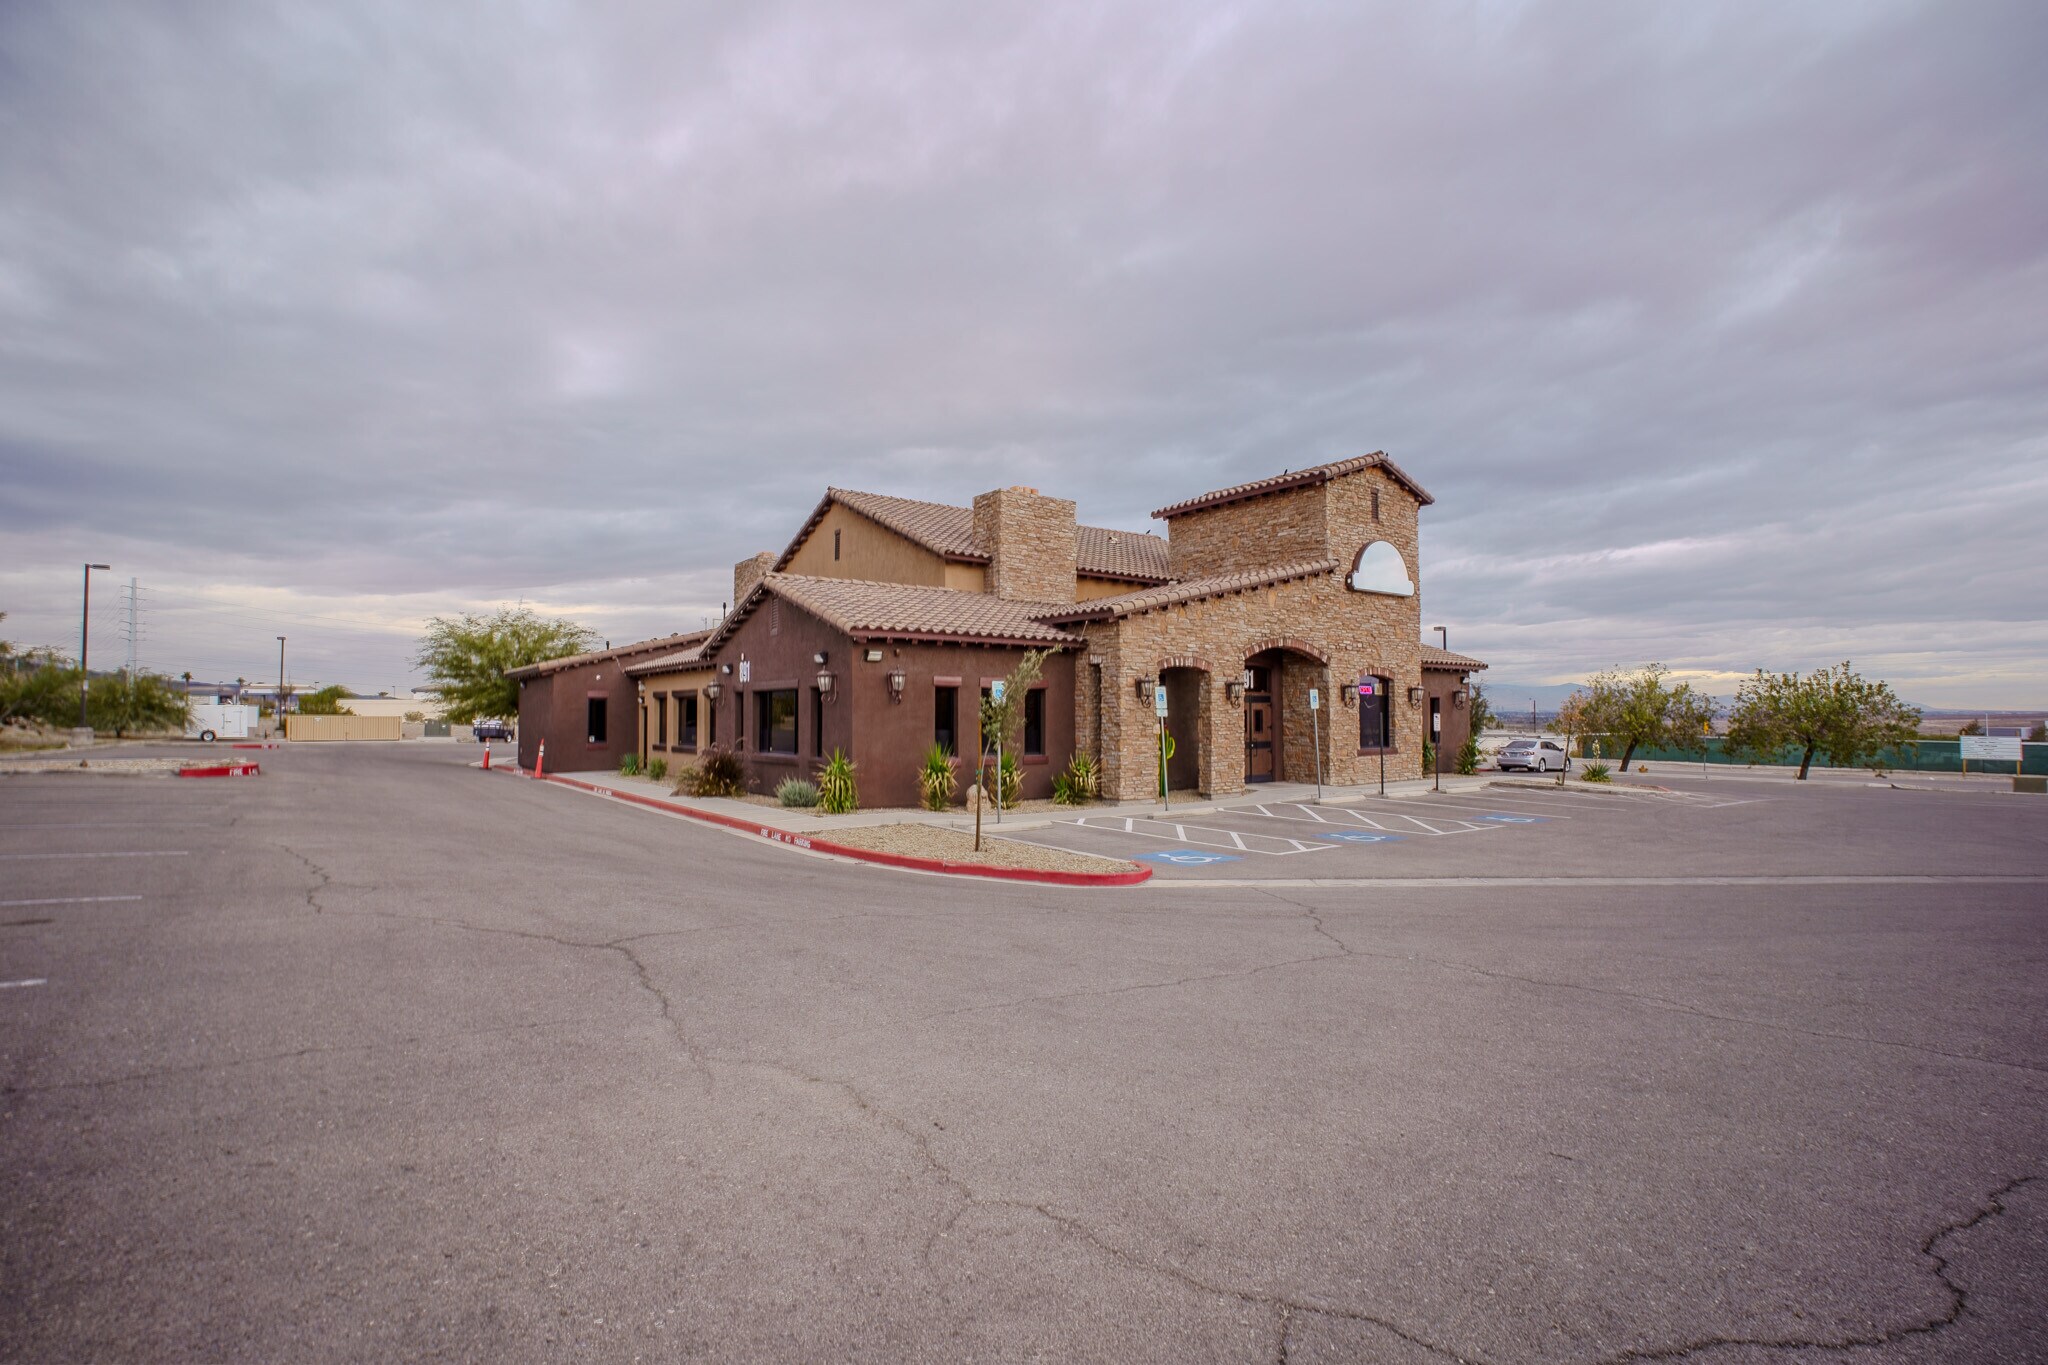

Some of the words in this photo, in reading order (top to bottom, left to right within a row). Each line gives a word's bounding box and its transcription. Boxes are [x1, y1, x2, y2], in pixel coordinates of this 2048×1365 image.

[740, 660, 750, 682] 891
[771, 830, 781, 841] LANE
[793, 836, 811, 849] PARKING
